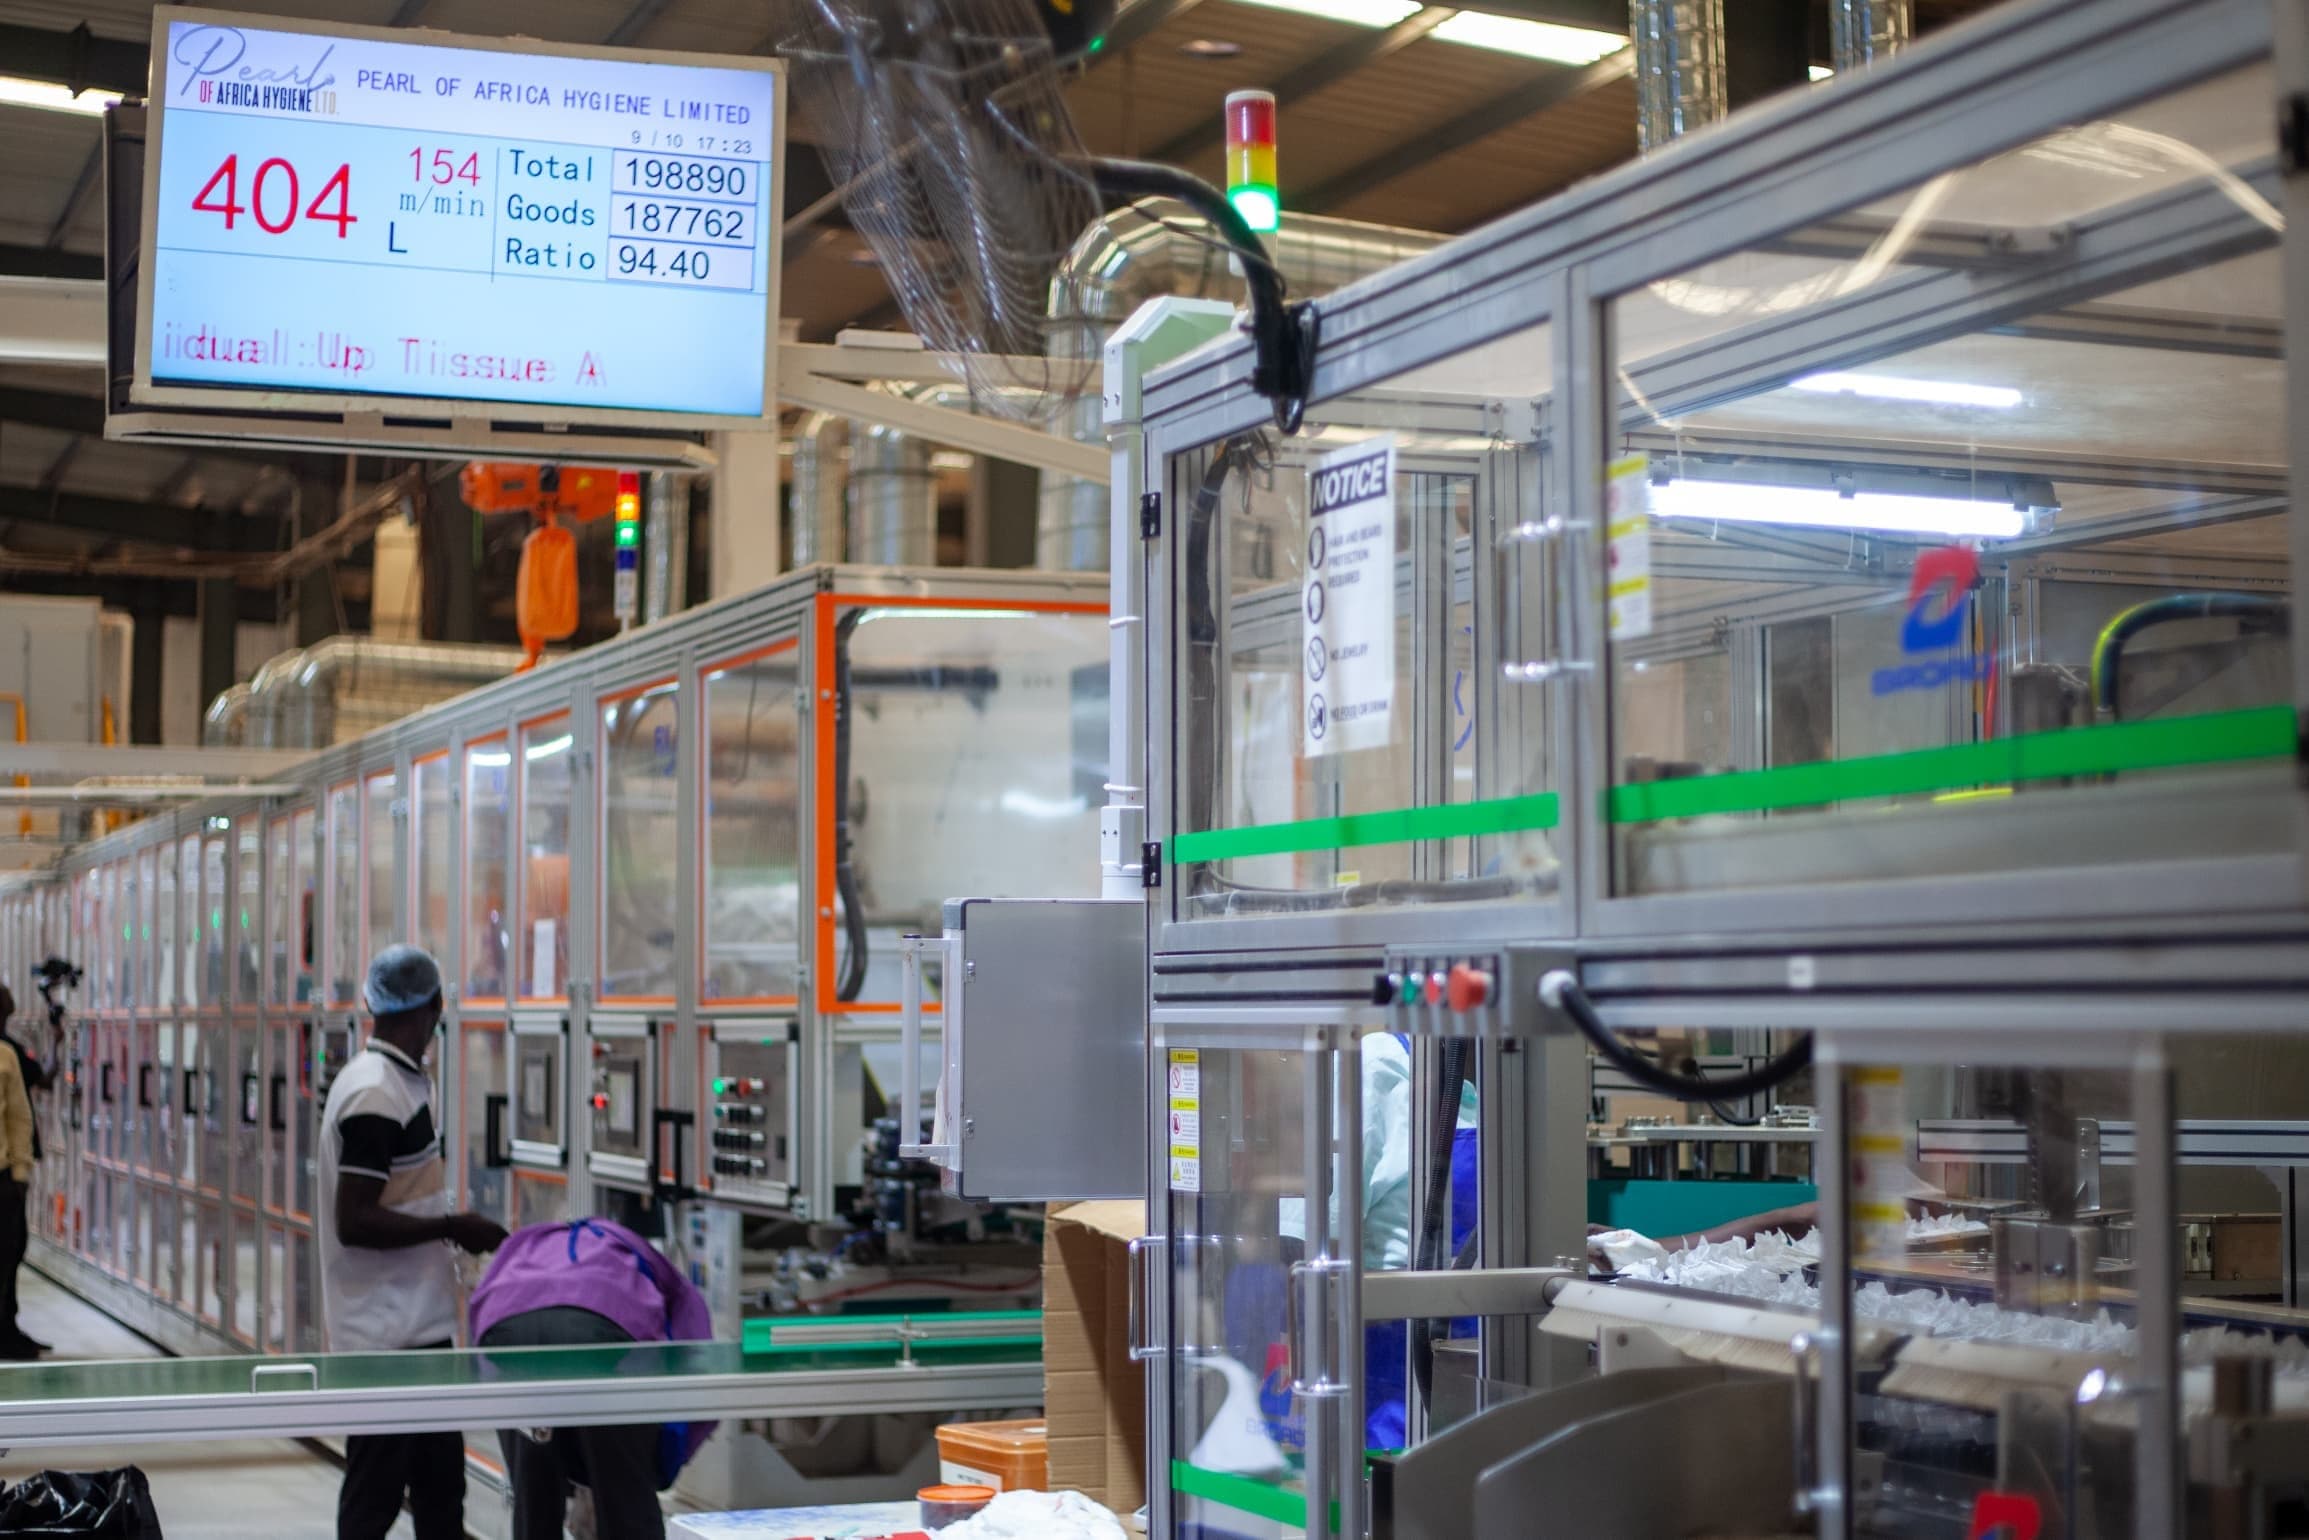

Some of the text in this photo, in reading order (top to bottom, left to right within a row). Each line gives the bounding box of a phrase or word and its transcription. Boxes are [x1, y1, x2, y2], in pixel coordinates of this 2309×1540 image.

[174, 25, 335, 96] Pearl
[199, 80, 214, 103] OF
[217, 81, 259, 108] AFRICA
[262, 85, 312, 112] HYGIENE
[357, 69, 750, 125] PEARL OF AFRICA HYGIENE LIMITED
[410, 146, 480, 187] 154
[510, 149, 746, 196] Total 198890
[192, 153, 358, 239] 404
[399, 186, 485, 217] m/min
[507, 193, 744, 240] Goods 187762
[389, 221, 408, 253] L
[506, 238, 710, 280] Ratio 94.40
[1313, 456, 1386, 511] NOTICE
